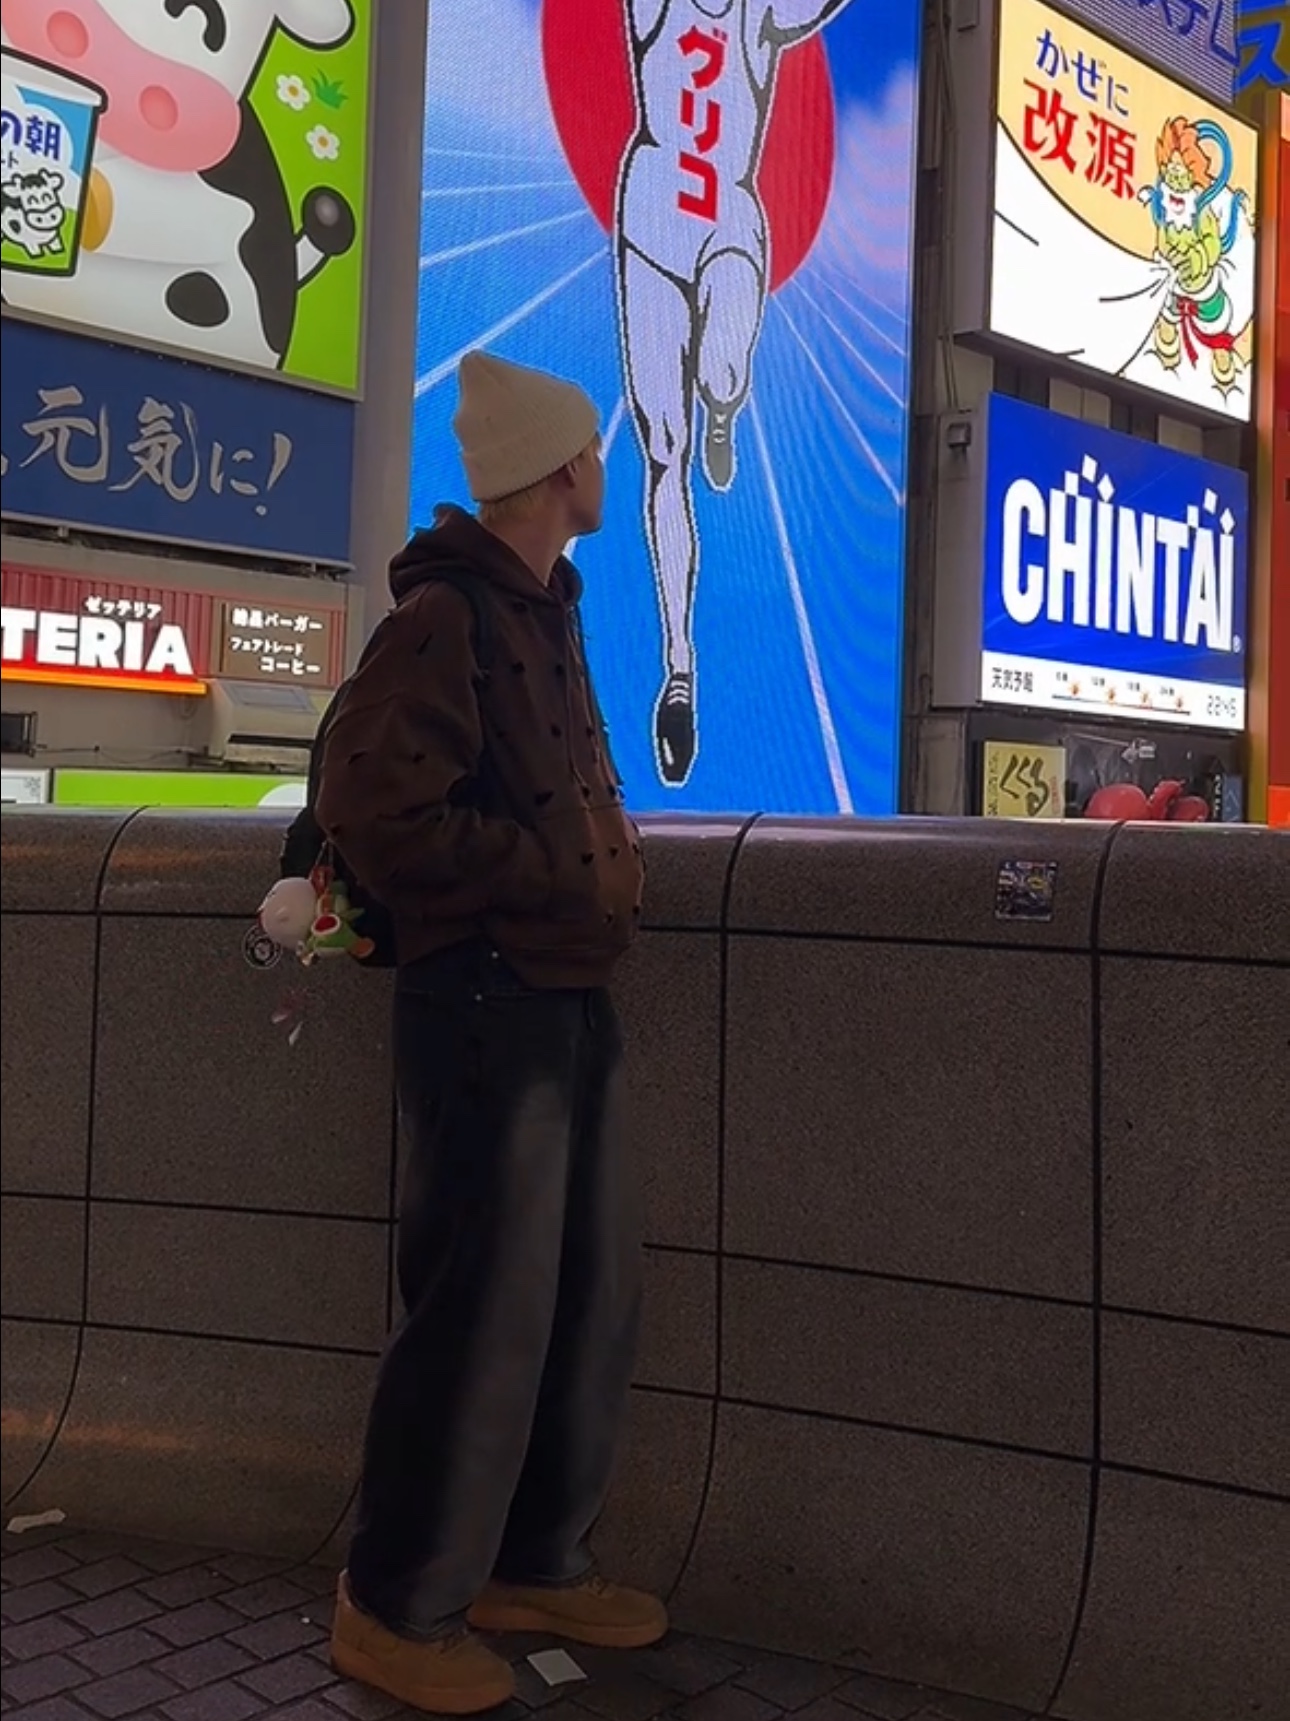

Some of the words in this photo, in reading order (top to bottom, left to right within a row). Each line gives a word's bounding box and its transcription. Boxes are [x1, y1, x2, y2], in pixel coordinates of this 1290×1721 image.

[676, 24, 728, 223] グリコ
[1036, 28, 1130, 117] かぜに
[1023, 77, 1137, 200] 改源
[1001, 453, 1235, 652] CHINTAI
[260, 656, 321, 675] コーヒー
